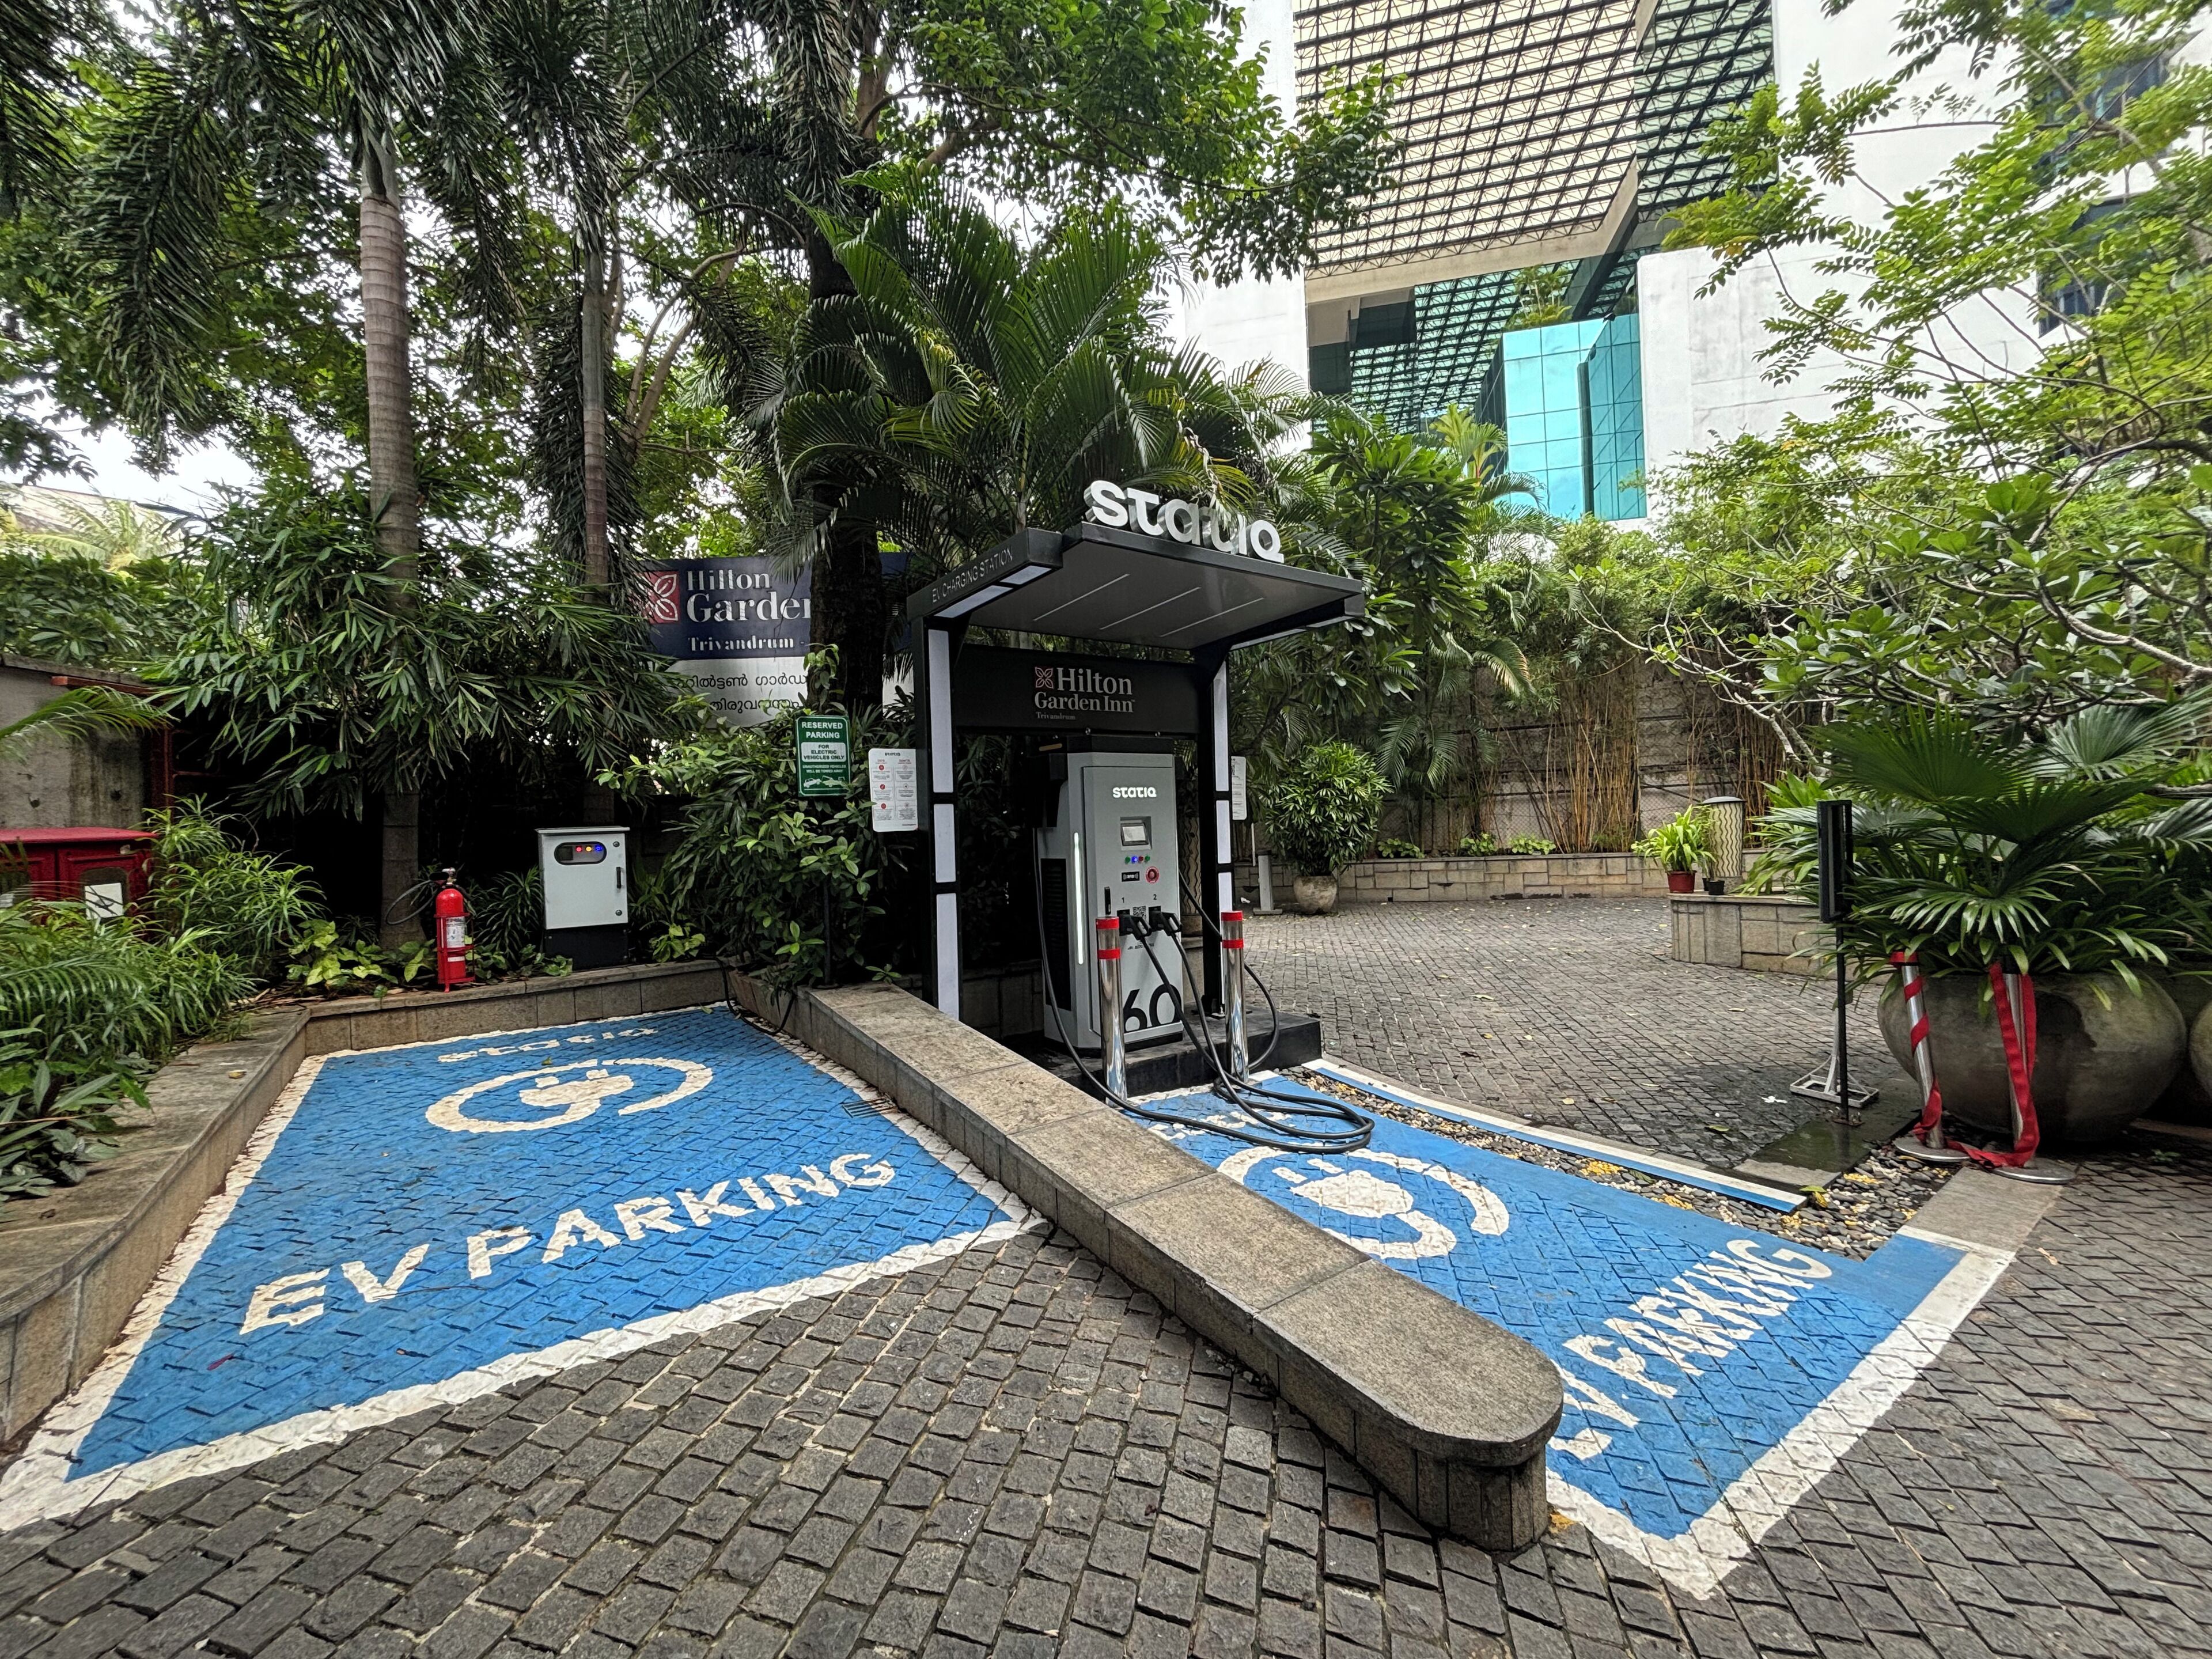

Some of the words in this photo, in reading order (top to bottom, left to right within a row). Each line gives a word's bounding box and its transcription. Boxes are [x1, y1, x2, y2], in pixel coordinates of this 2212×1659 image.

[687, 569, 772, 590] Hilton
[942, 566, 979, 597] CHARGING
[980, 546, 1013, 577] STATION
[688, 635, 794, 651] Trivandrum
[1056, 668, 1132, 695] Hilton
[1035, 691, 1101, 711] Garden
[801, 721, 843, 729] RESERVED
[1036, 711, 1076, 720] Trivandrum
[1123, 983, 1183, 1033] 60
[239, 1243, 430, 1335] EV
[467, 1154, 895, 1279] PARKING
[1562, 1240, 1832, 1399] PARKING
